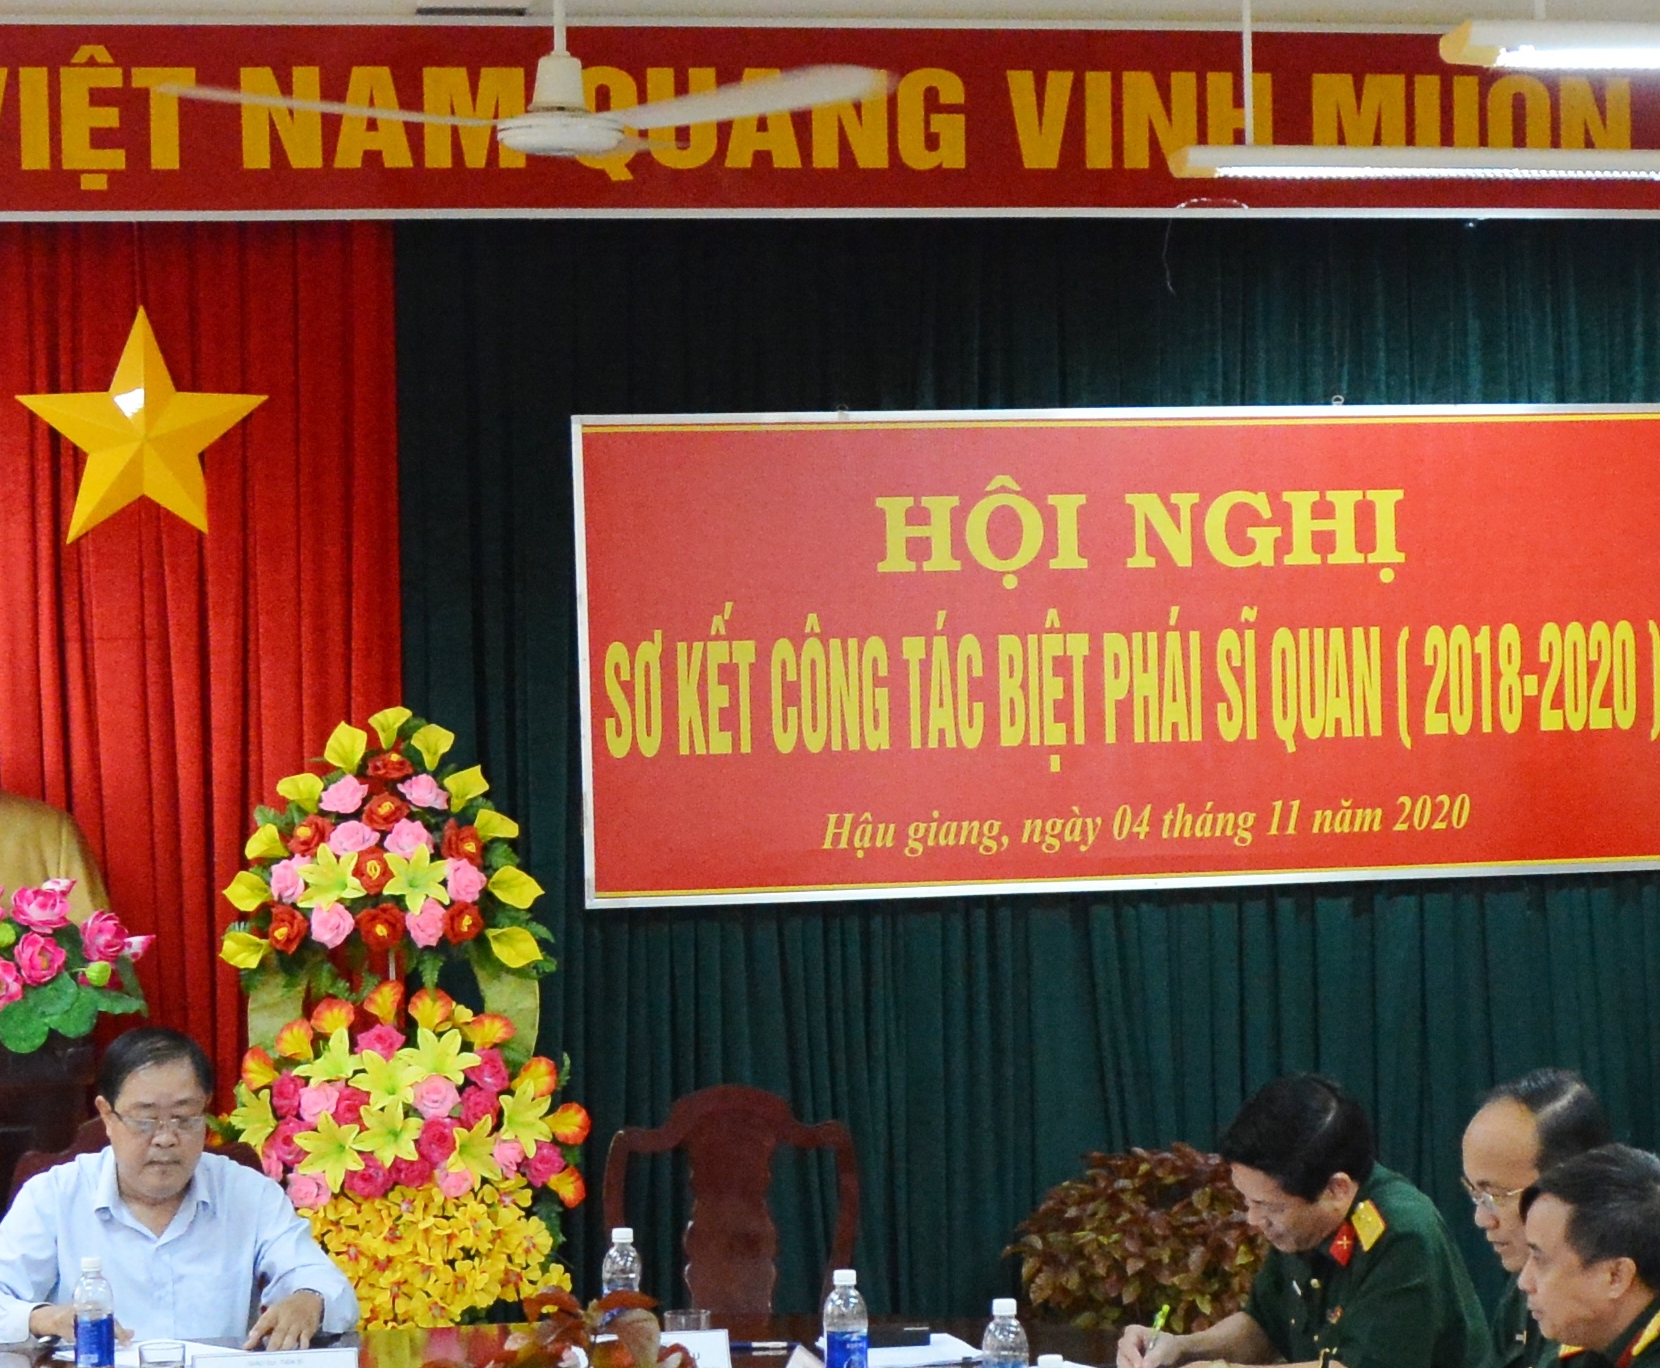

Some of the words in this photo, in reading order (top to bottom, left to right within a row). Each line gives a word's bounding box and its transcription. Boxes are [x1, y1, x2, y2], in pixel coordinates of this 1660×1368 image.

[241, 65, 527, 170] NAM
[1007, 70, 1275, 170] VINH
[875, 474, 1089, 590] HỘI
[1125, 488, 1406, 584] NGHỊ
[604, 629, 663, 759] SƠ
[676, 601, 756, 756] KẾT
[770, 612, 890, 754] CÔNG
[902, 610, 985, 749] TÁC
[997, 608, 1089, 773] BIỆT
[1103, 605, 1203, 743] PHÁI
[1216, 606, 1258, 742] SĨ
[1270, 625, 1383, 753] QUAN
[1423, 620, 1637, 736] 2018-2020
[821, 812, 896, 858] Hậu
[905, 810, 1011, 857] giang,
[1021, 805, 1103, 852] ngày
[1112, 803, 1152, 840] 04
[1161, 800, 1257, 846] tháng
[1267, 798, 1300, 836] 11
[1311, 796, 1383, 834] năm
[1393, 793, 1471, 831] 2020
